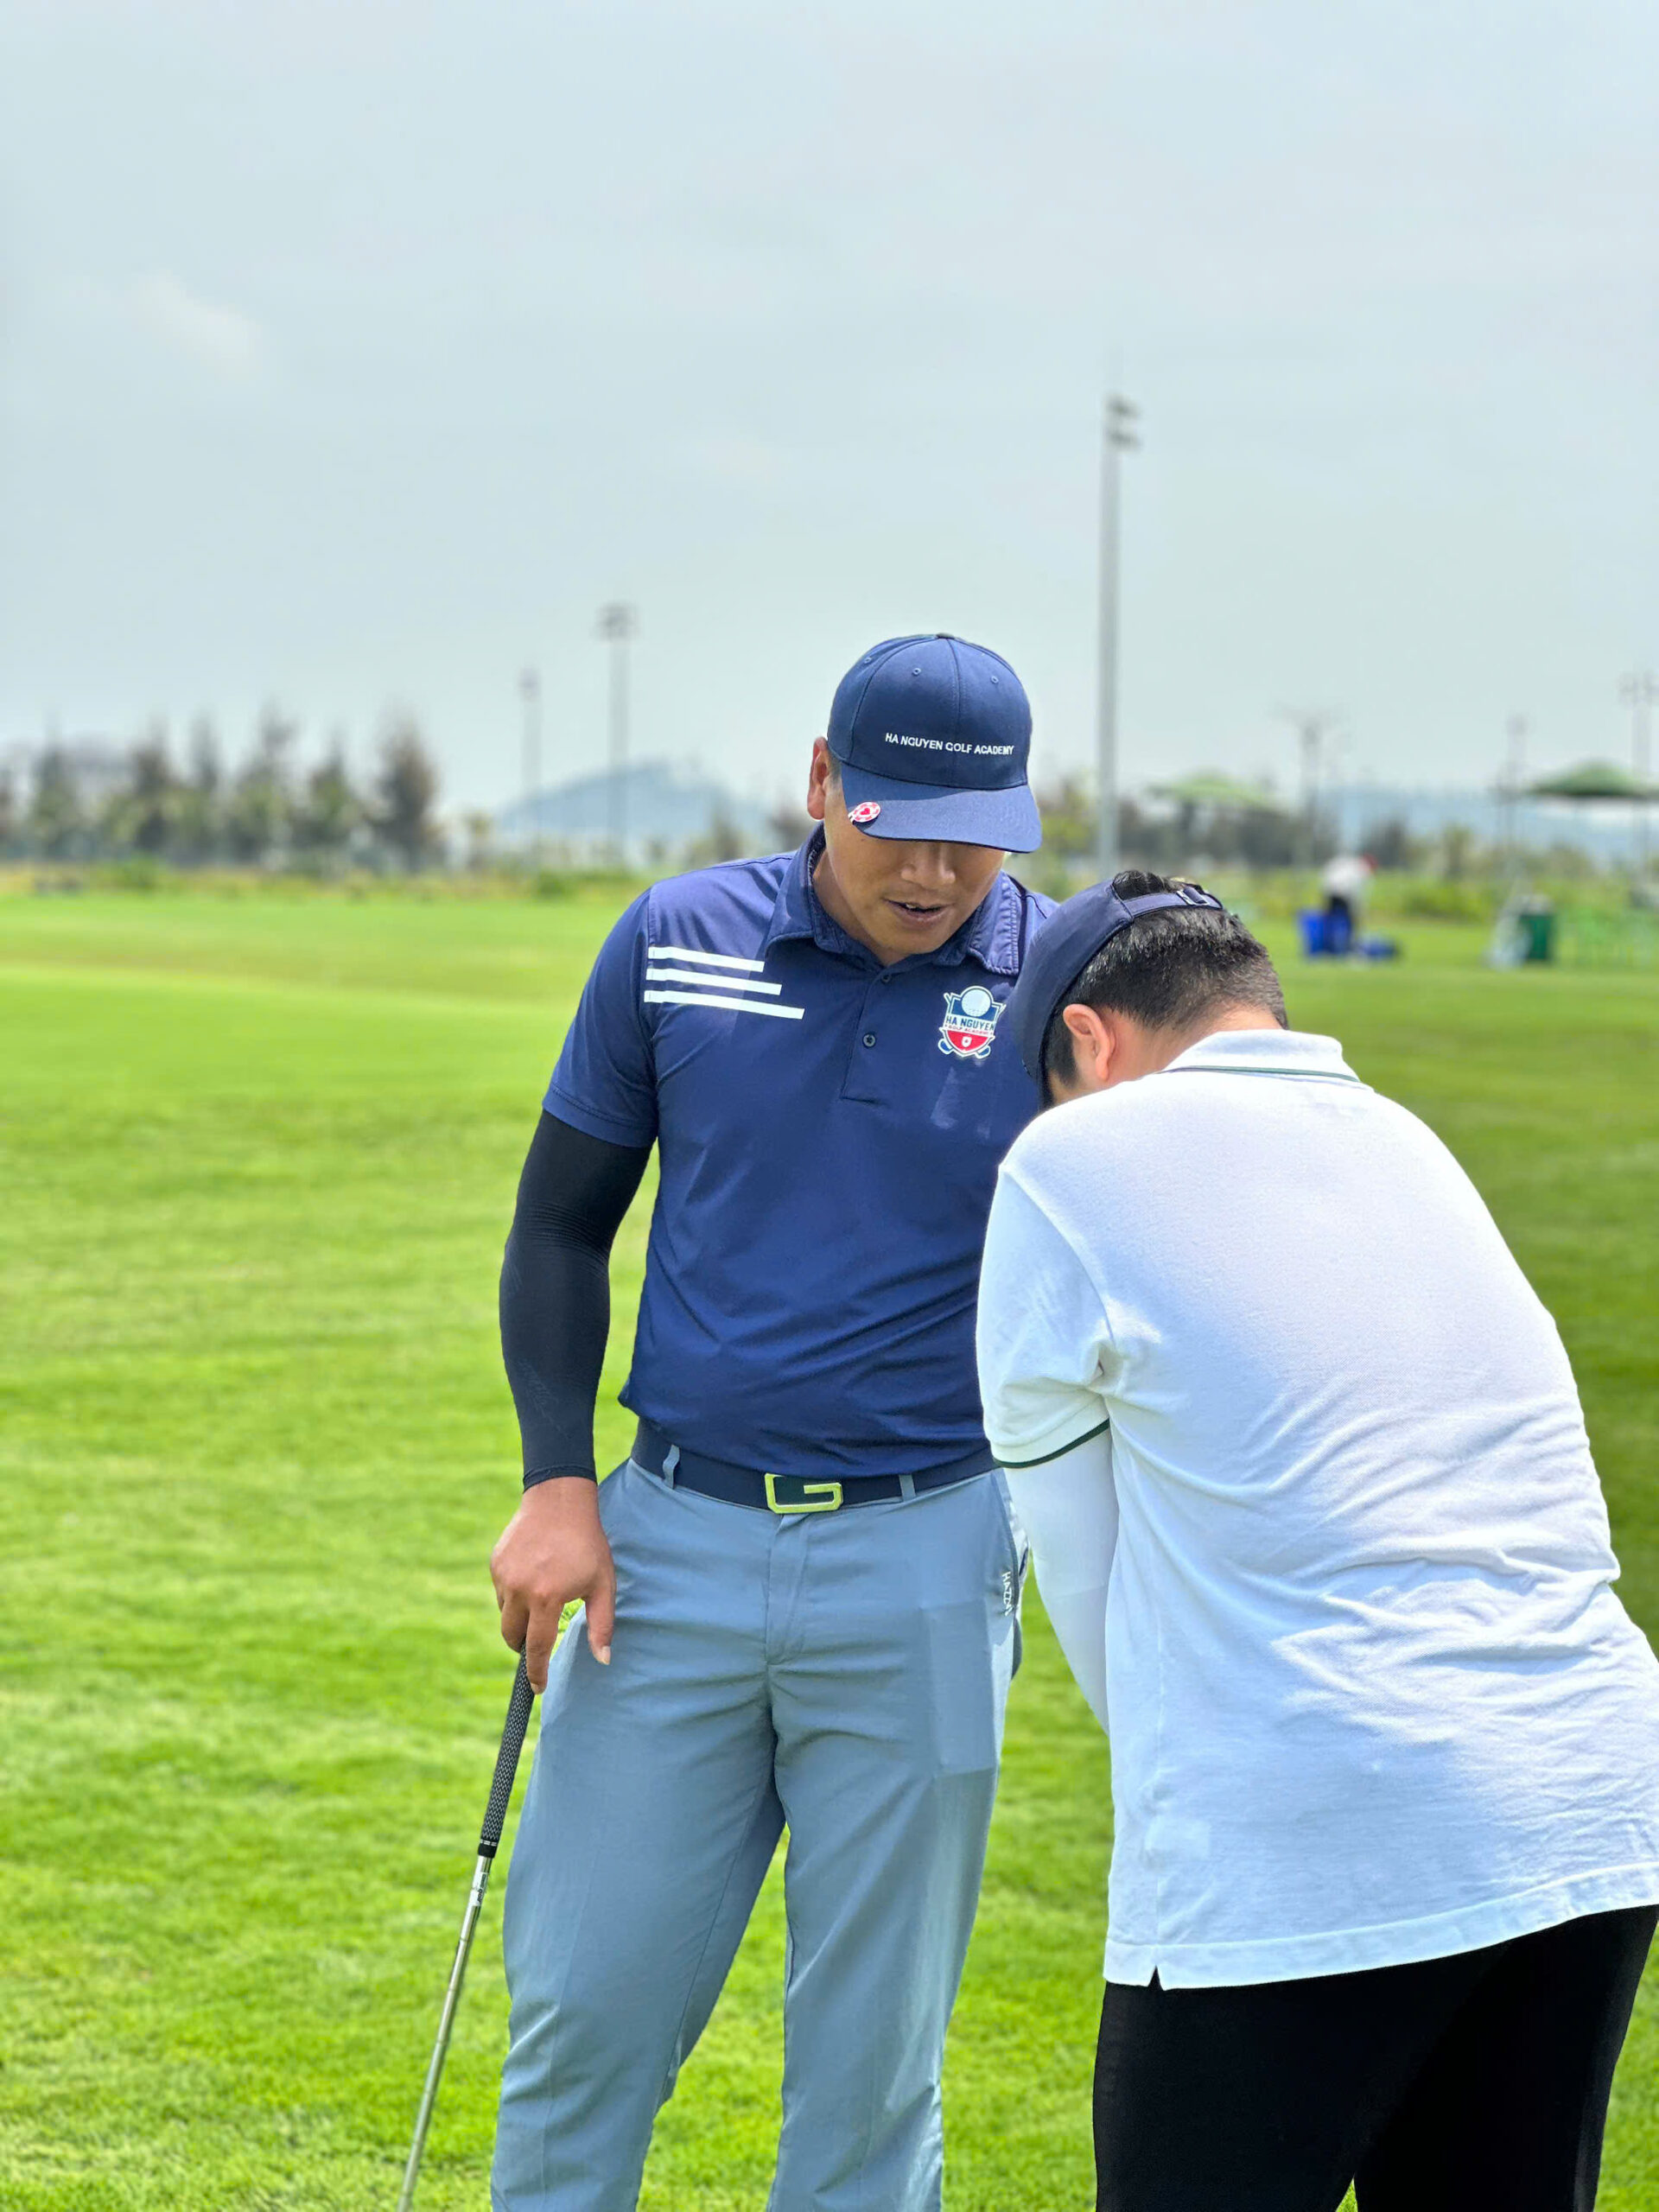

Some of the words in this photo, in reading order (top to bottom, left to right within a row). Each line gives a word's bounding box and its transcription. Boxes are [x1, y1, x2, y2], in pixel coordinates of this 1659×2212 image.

[886, 733, 899, 744] HA
[900, 735, 943, 750] NGUYEN
[945, 742, 972, 753] GOLF
[974, 745, 1014, 755] ACADEMY
[946, 1015, 957, 1025] HA
